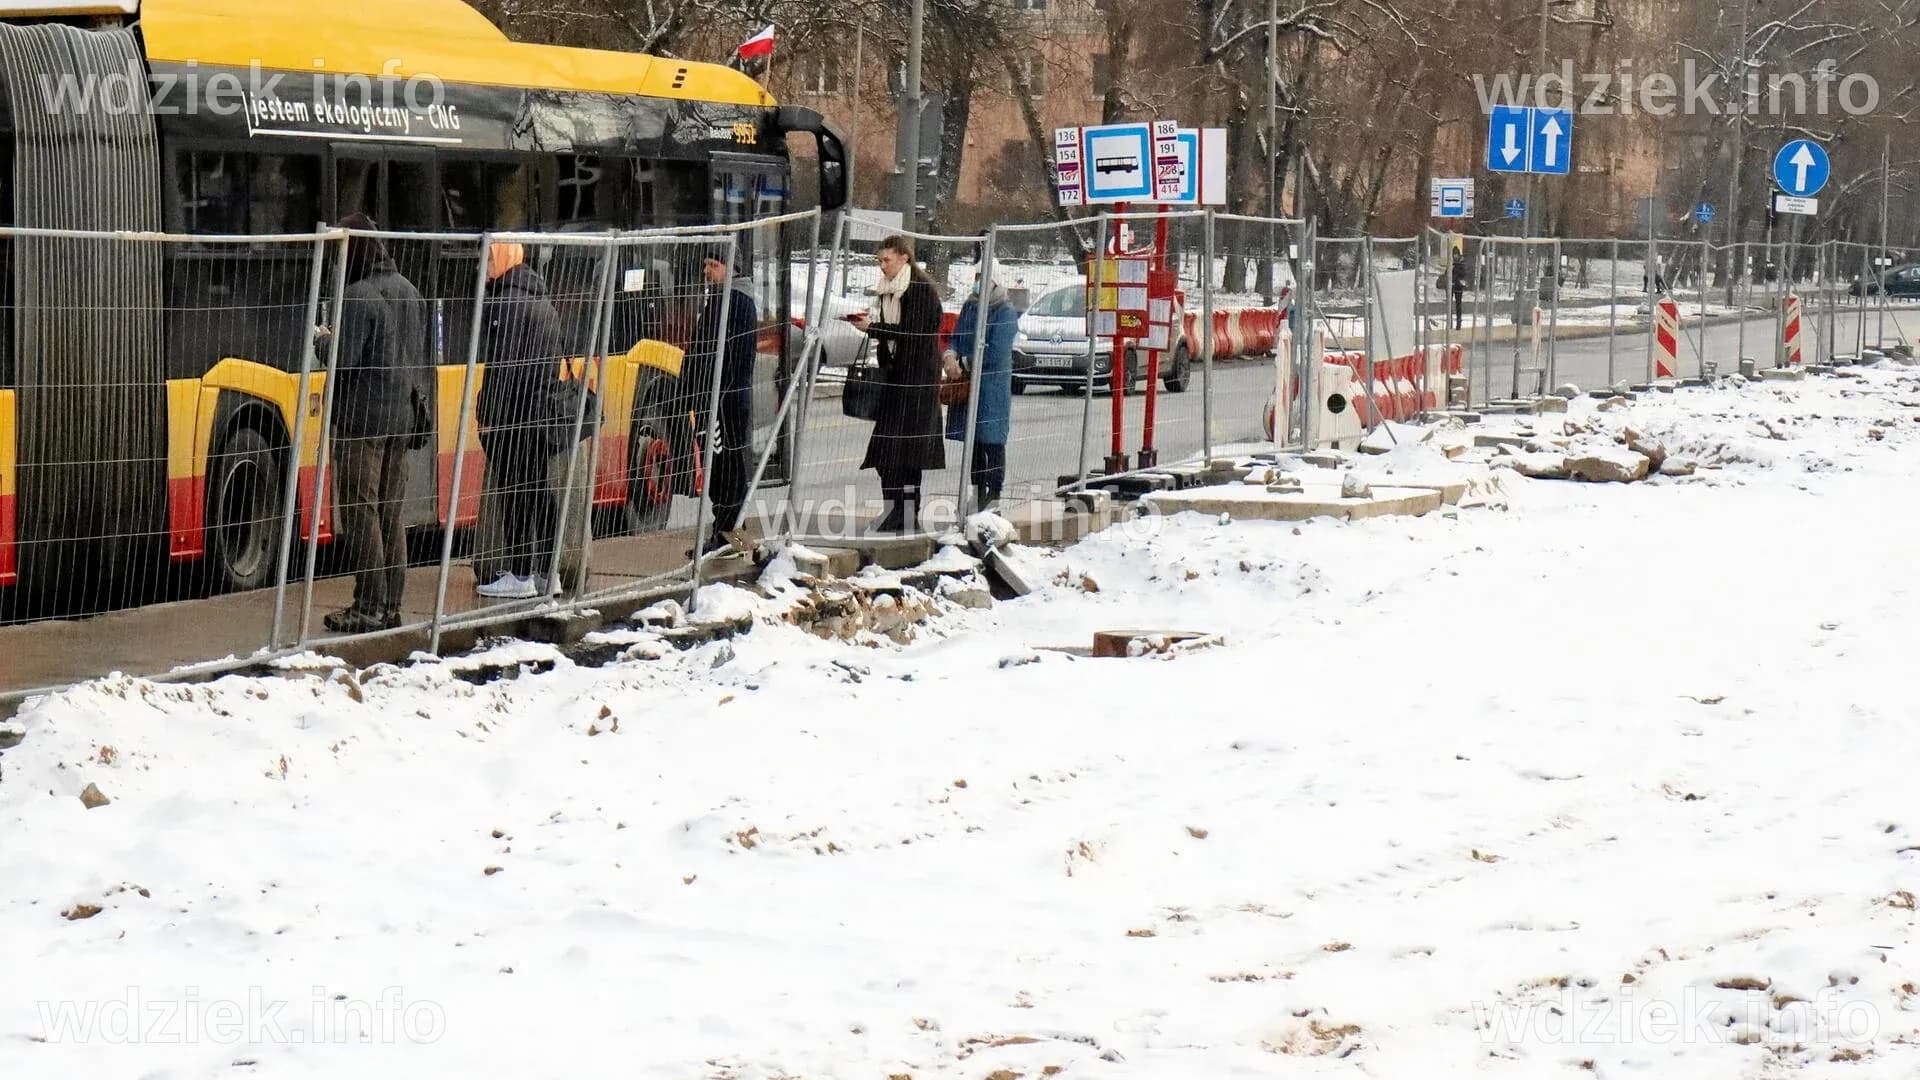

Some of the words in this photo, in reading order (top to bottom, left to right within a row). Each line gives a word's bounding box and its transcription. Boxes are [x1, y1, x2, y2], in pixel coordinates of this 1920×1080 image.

[250, 91, 309, 127] jestem
[314, 96, 409, 134] ekologiczny
[427, 103, 461, 130] CNG
[1158, 123, 1175, 135] 186
[1059, 130, 1076, 142] 136
[1059, 149, 1077, 161] 154
[1160, 143, 1176, 155] 191
[1061, 190, 1079, 200] 172
[1161, 184, 1178, 194] 414
